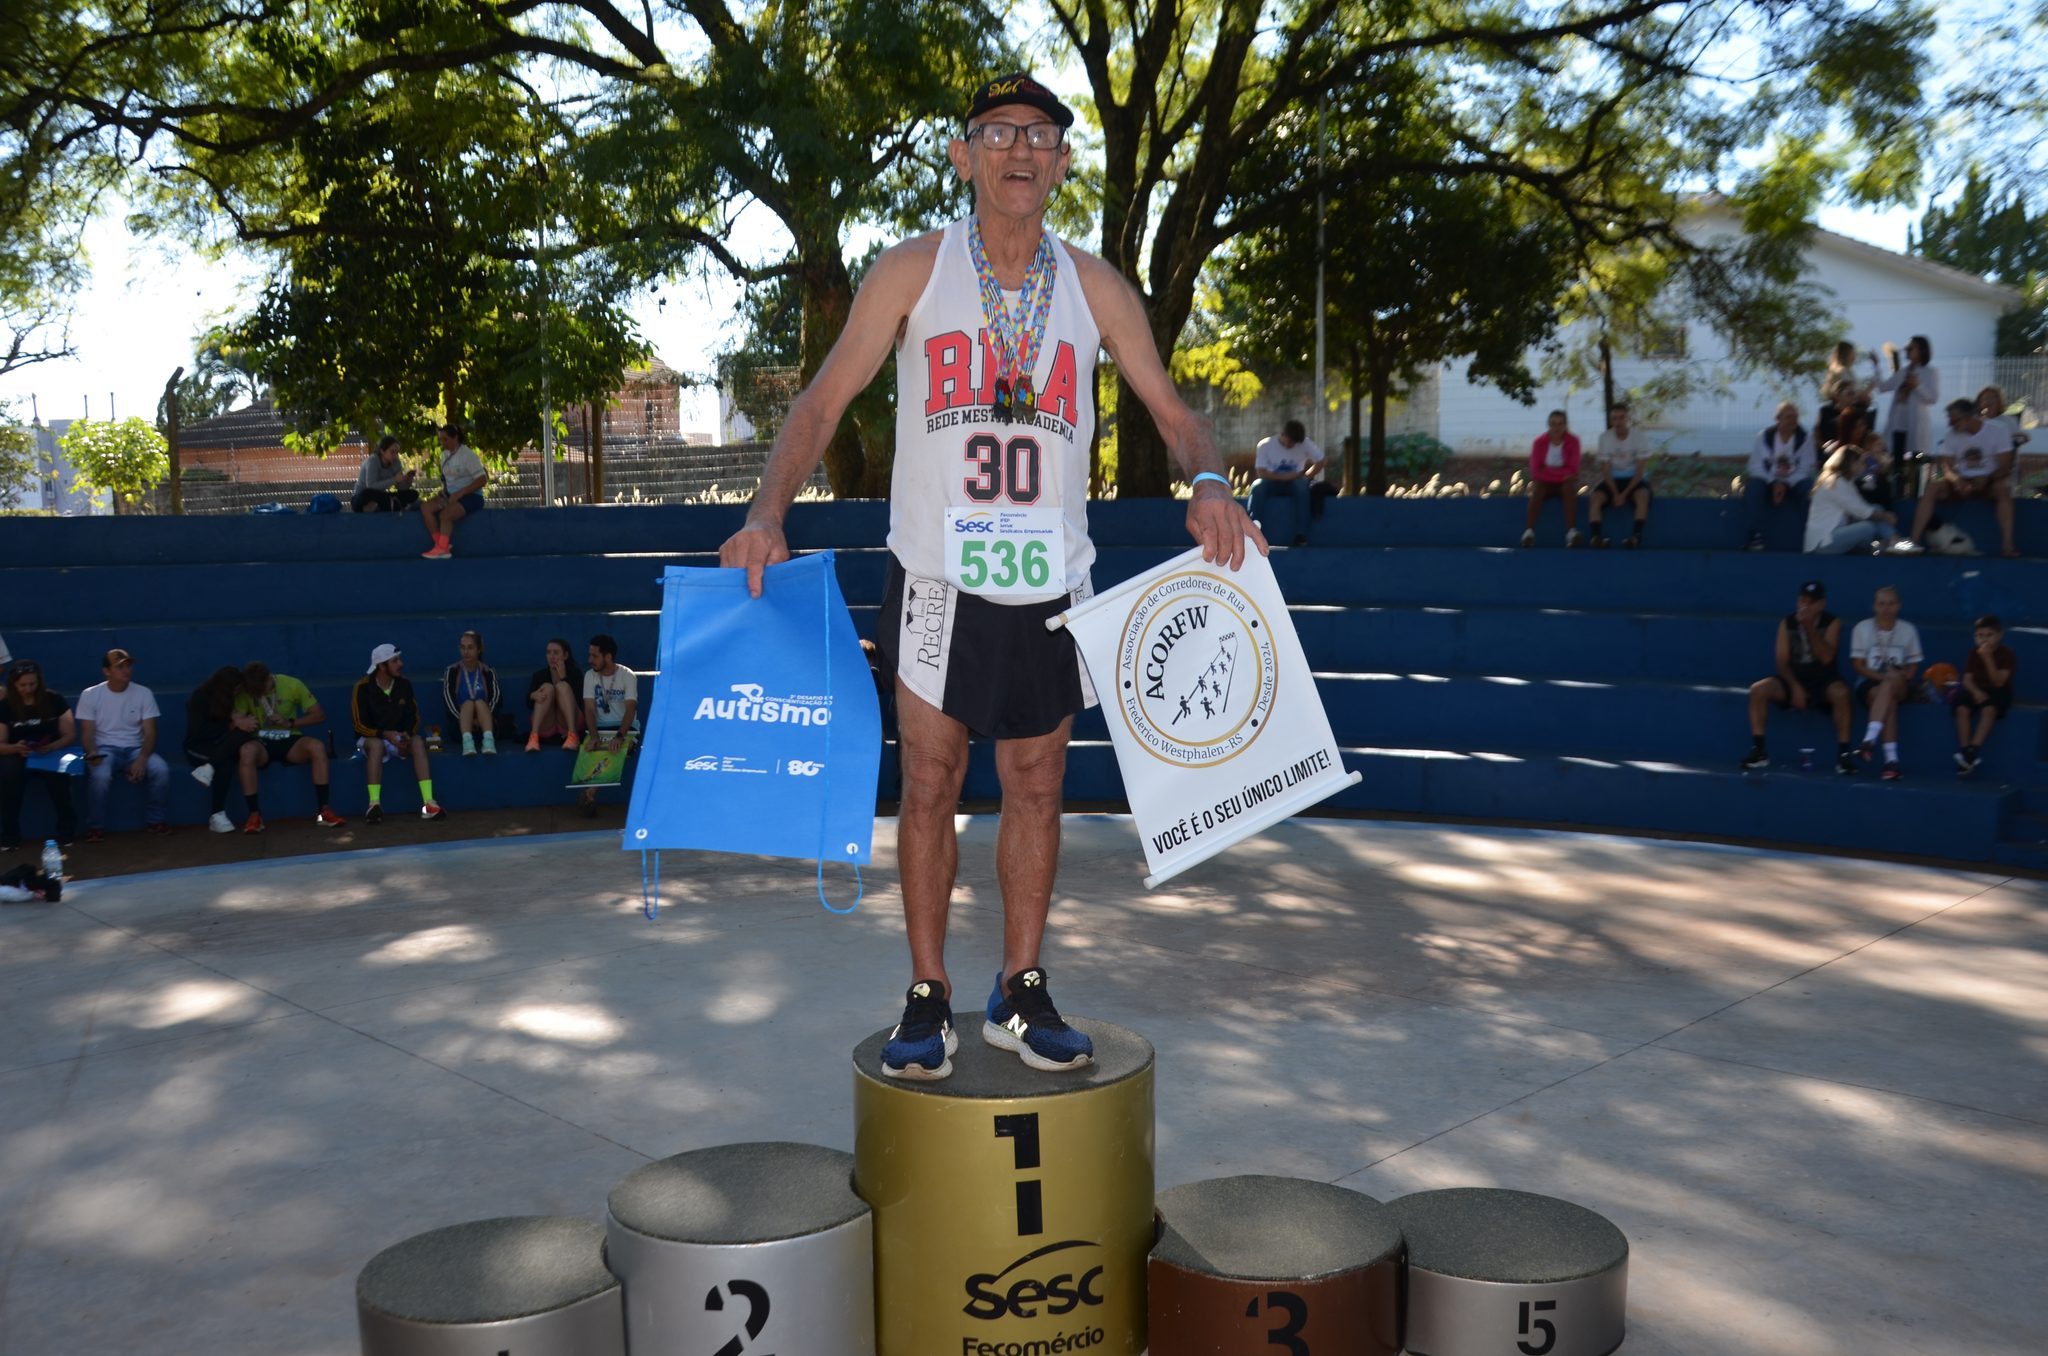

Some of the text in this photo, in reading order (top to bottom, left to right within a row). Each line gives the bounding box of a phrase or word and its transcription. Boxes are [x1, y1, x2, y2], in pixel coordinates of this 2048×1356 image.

[927, 411, 958, 434] REDE
[962, 408, 1012, 425] MEST
[963, 431, 1042, 506] 30
[955, 518, 994, 533] Sesc
[960, 540, 1050, 588] 536
[1122, 576, 1246, 670] Associação de Corredores de Rua
[1145, 605, 1210, 701] ACORFW
[1257, 640, 1274, 713] Desde 2024
[694, 697, 832, 726] Autismo
[1126, 697, 1160, 747] Frederico
[1152, 748, 1333, 855] VOCÊ É O SEU ÚNICO LIMITE!
[993, 1112, 1044, 1236] 1
[704, 1278, 776, 1356] 2
[962, 1262, 1105, 1320] Sesc
[962, 1326, 1105, 1356] Fecomércio
[1245, 1290, 1311, 1356] 3
[1516, 1299, 1558, 1356] 5
